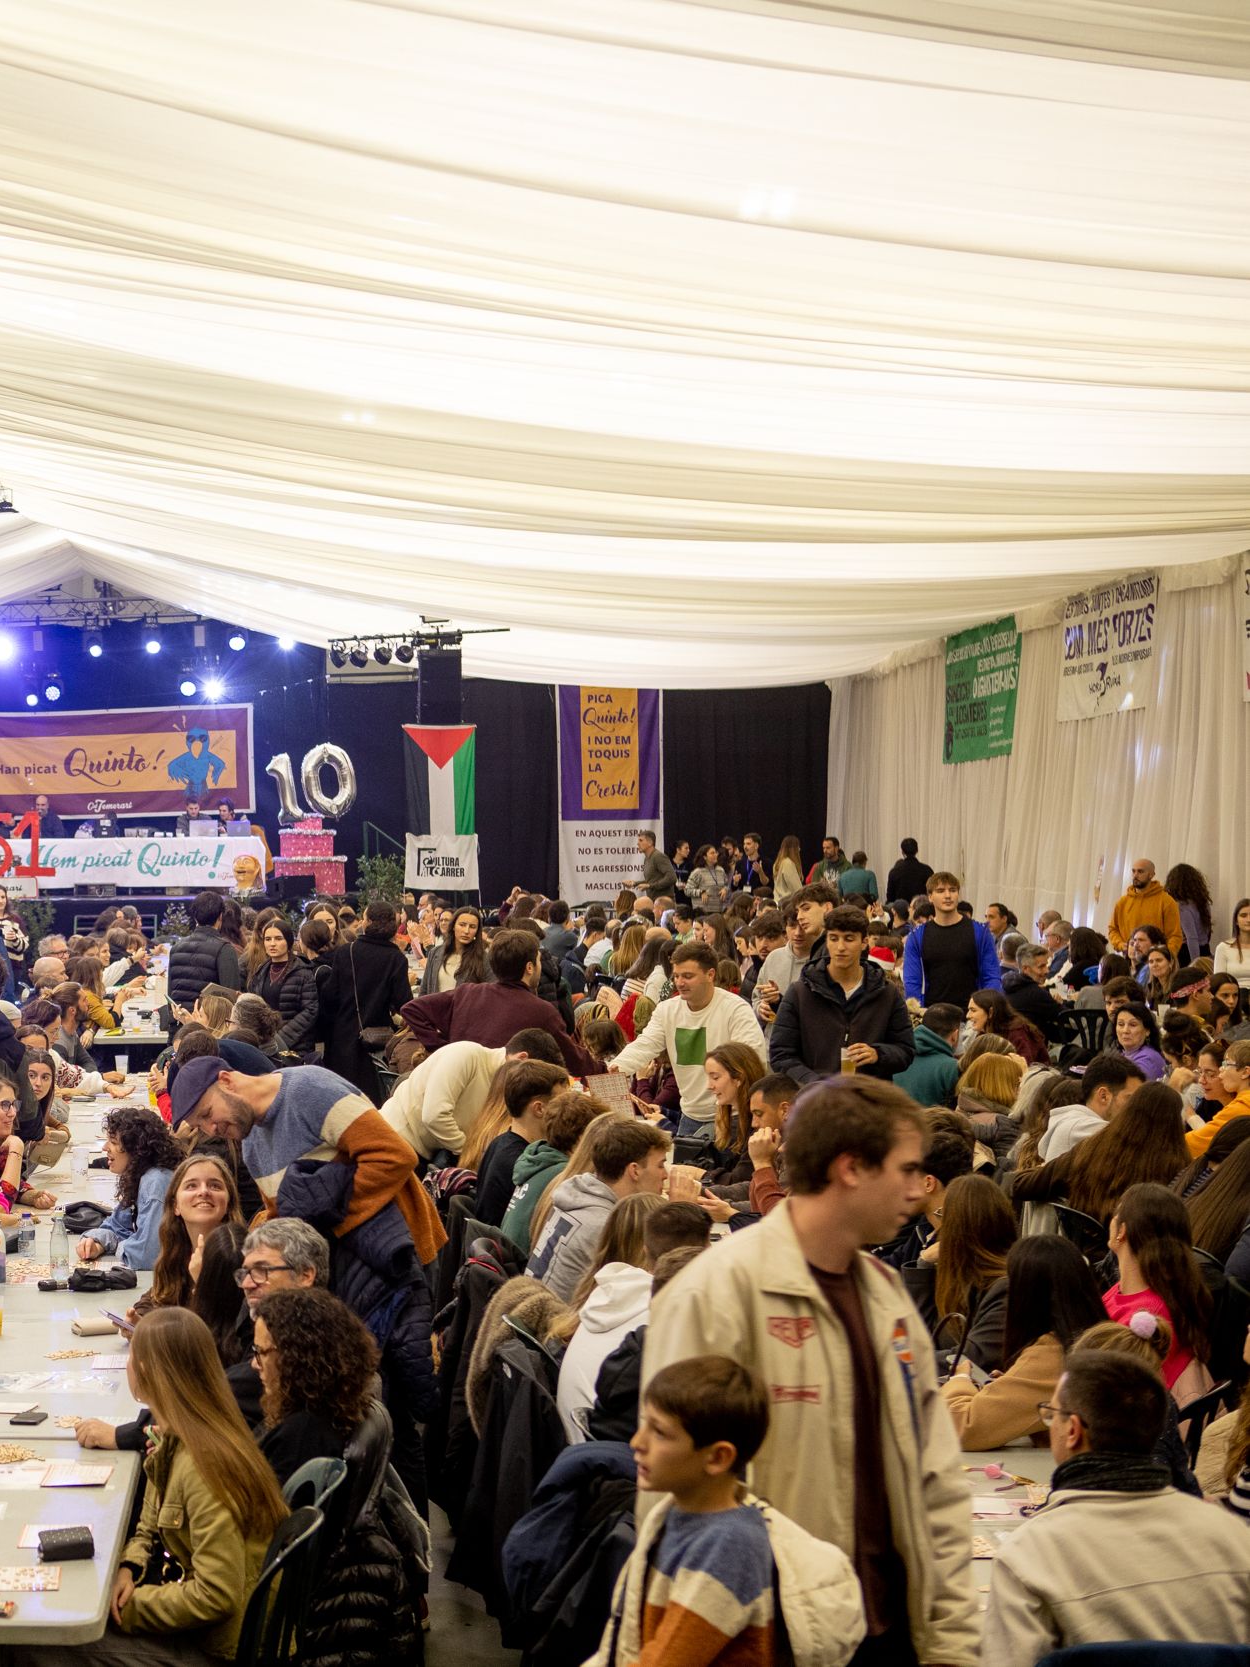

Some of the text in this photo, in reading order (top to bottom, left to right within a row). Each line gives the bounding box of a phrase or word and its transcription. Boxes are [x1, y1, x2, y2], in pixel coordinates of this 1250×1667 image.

[587, 694, 613, 704] PICA
[582, 707, 636, 733] Quinto!
[588, 735, 631, 745] I NO EM
[588, 749, 630, 760] TOQUIS
[25, 763, 58, 777] picat
[64, 745, 166, 787] Quinto!
[588, 763, 602, 772] LA
[265, 742, 358, 826] 10
[586, 779, 636, 799] Cresta!
[575, 830, 587, 838] EN
[589, 829, 622, 838] AQUEST
[82, 849, 133, 872] picat
[137, 842, 225, 879] Quinto!
[576, 864, 645, 873] LES AGRESSIONS
